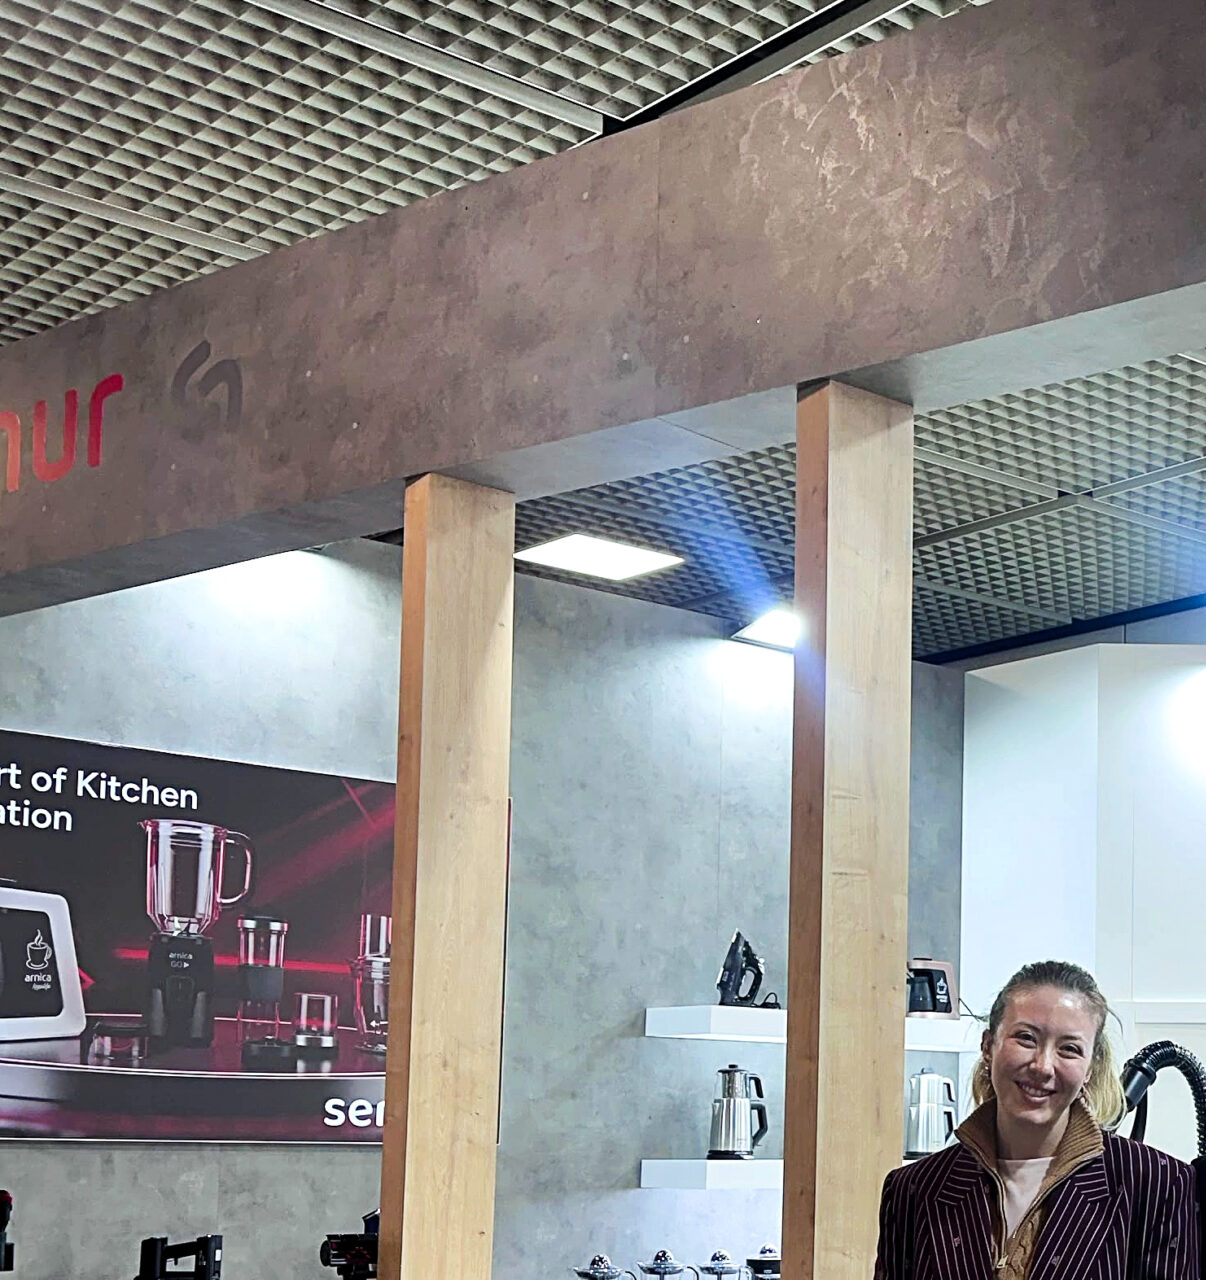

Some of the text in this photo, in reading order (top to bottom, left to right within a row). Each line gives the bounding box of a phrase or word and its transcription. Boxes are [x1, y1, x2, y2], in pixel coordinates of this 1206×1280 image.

[31, 767, 68, 794] of
[76, 770, 198, 810] Kitchen
[24, 972, 52, 983] arnica
